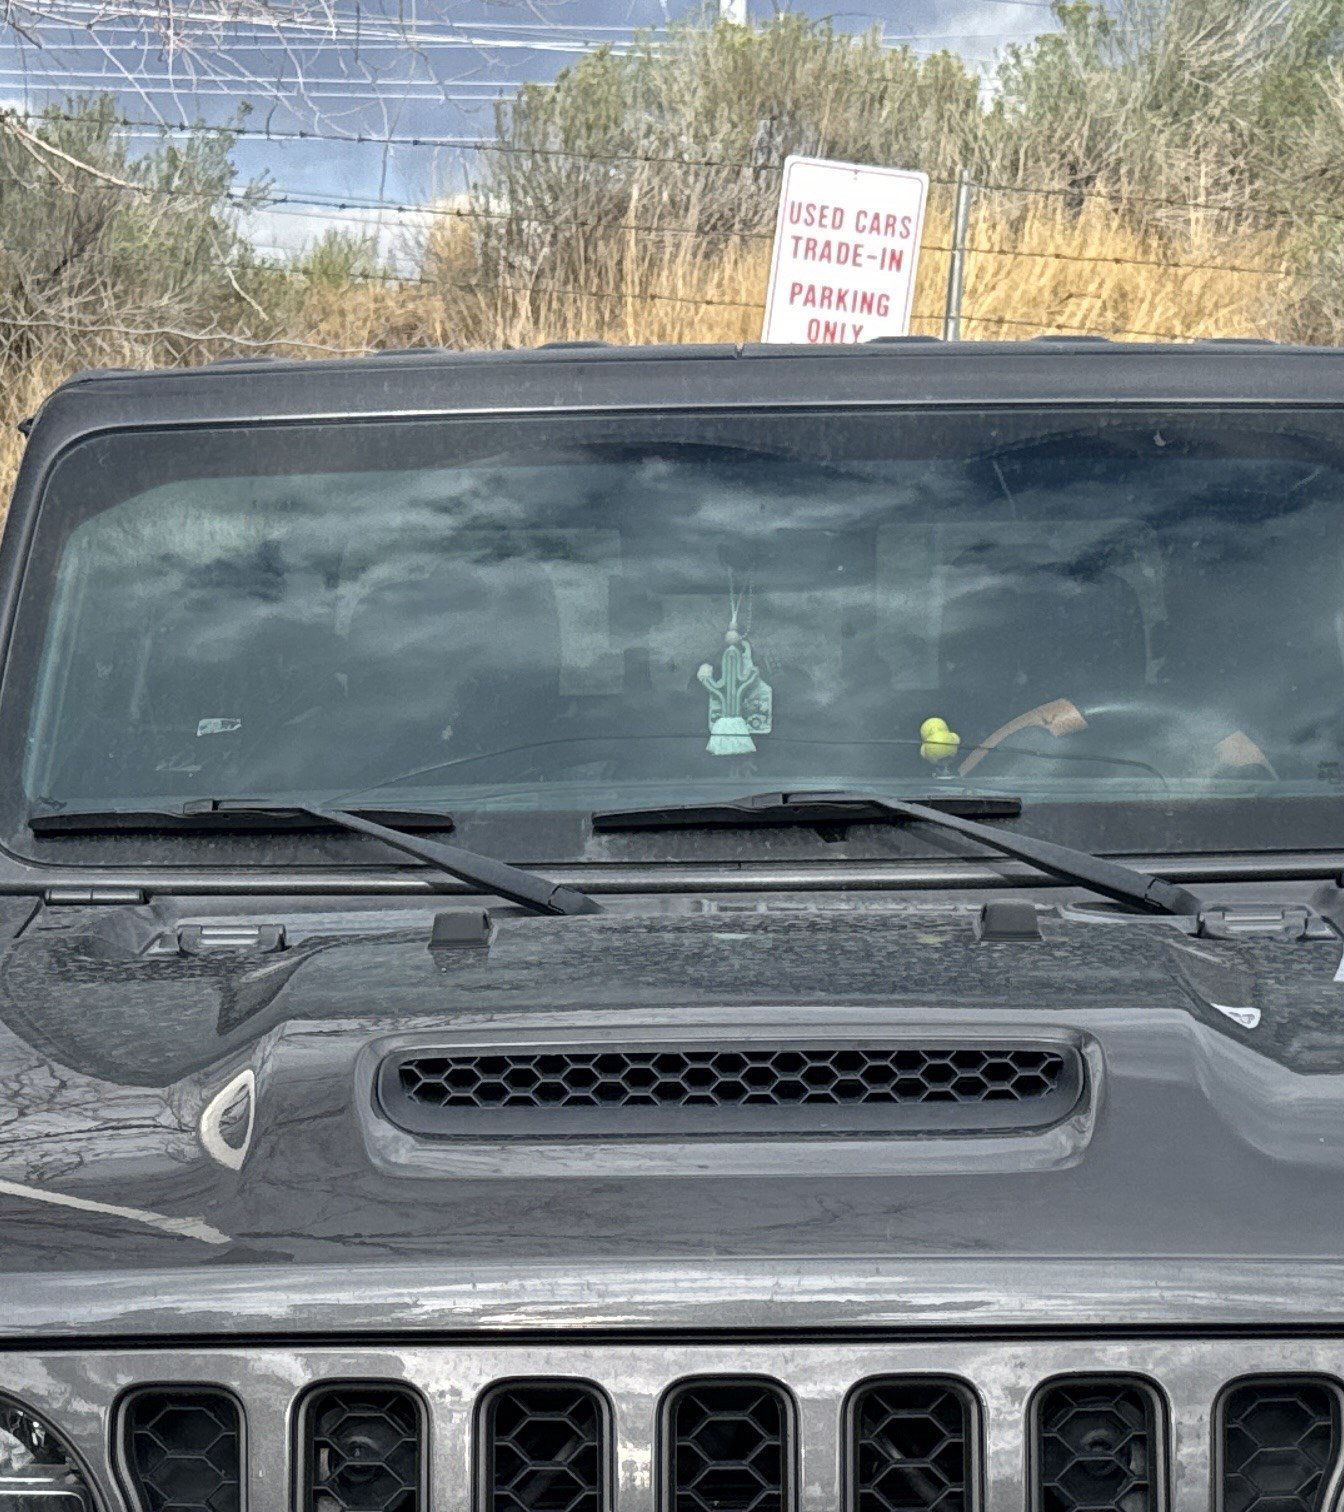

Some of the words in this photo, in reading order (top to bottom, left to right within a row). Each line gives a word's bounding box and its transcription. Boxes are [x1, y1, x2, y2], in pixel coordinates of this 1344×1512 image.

[789, 201, 845, 230] USED
[855, 209, 912, 239] CARS
[791, 235, 904, 273] TRADE-IN
[789, 282, 891, 318] PARKING
[807, 318, 864, 344] ONLY
